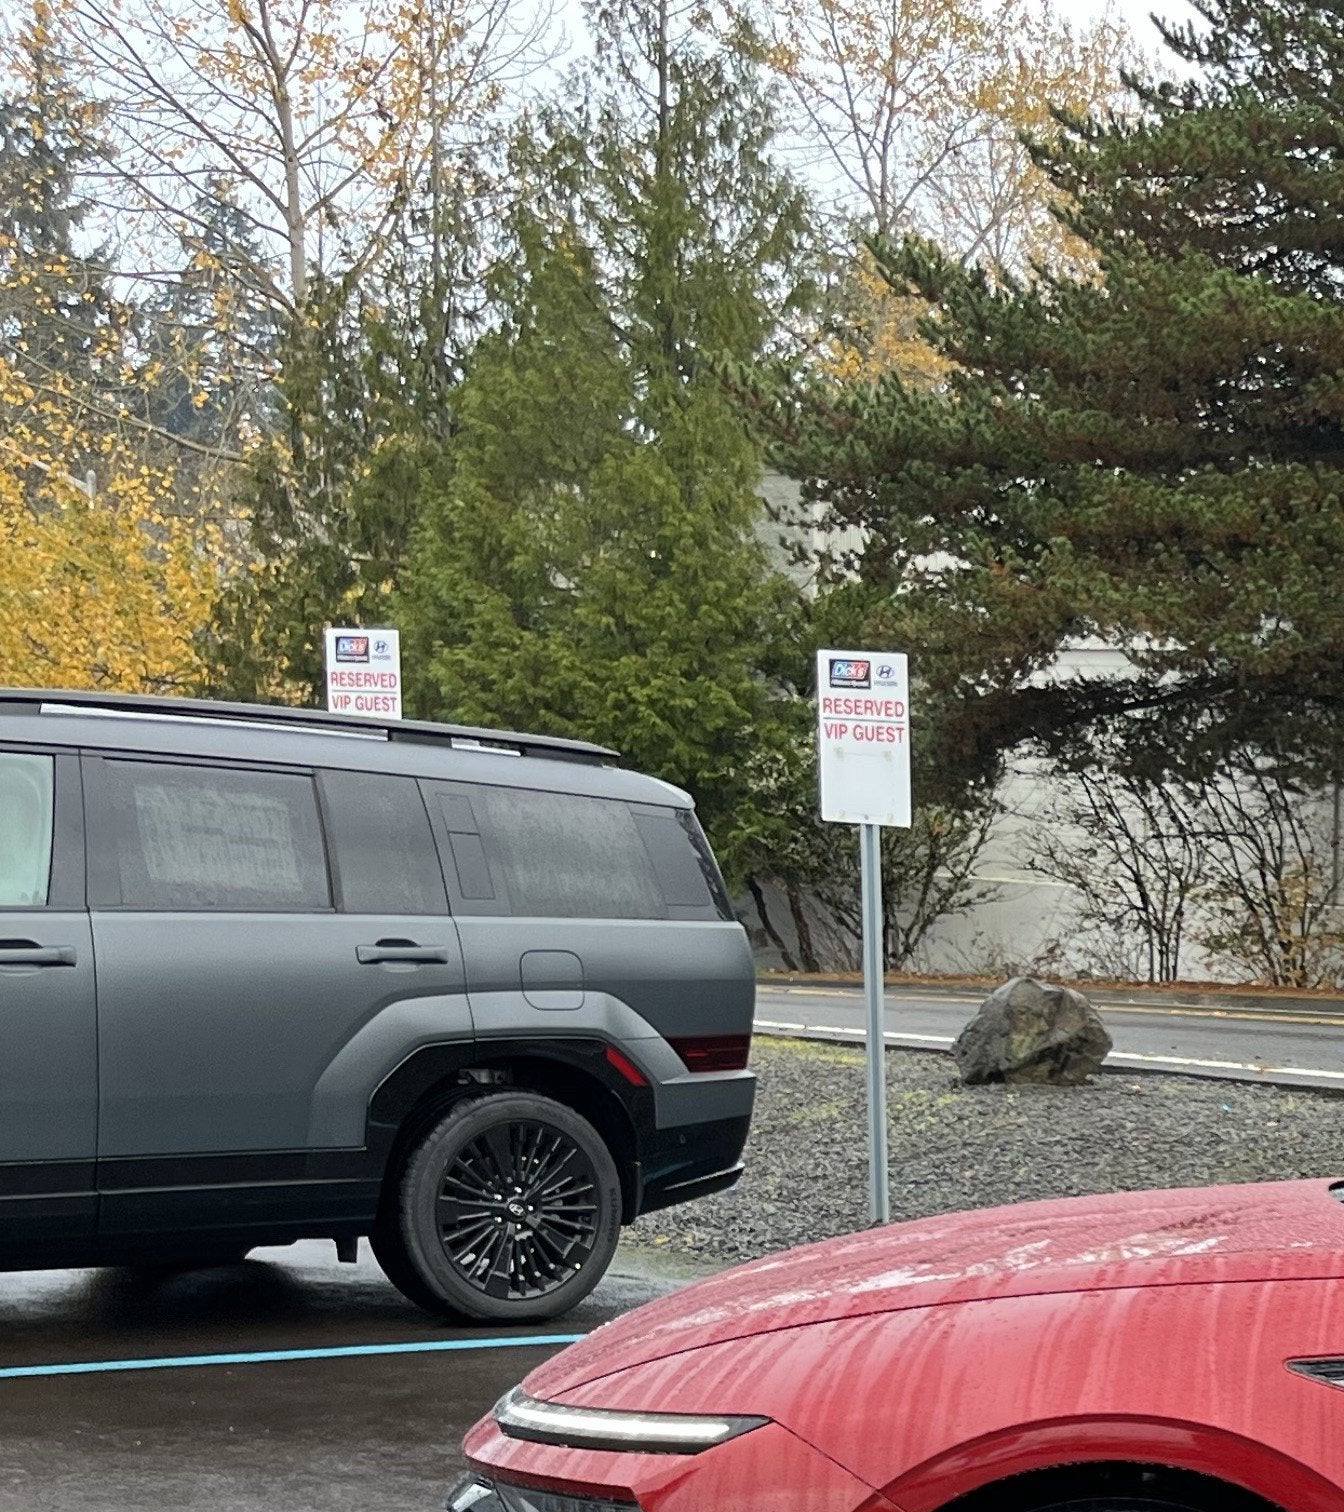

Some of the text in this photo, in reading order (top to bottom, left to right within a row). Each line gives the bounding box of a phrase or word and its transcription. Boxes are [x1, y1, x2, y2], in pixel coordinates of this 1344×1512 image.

[330, 671, 397, 688] RESERVED
[331, 694, 397, 712] VIP GUEST
[822, 697, 905, 717] RESERVED
[824, 722, 905, 743] VIP GUEST
